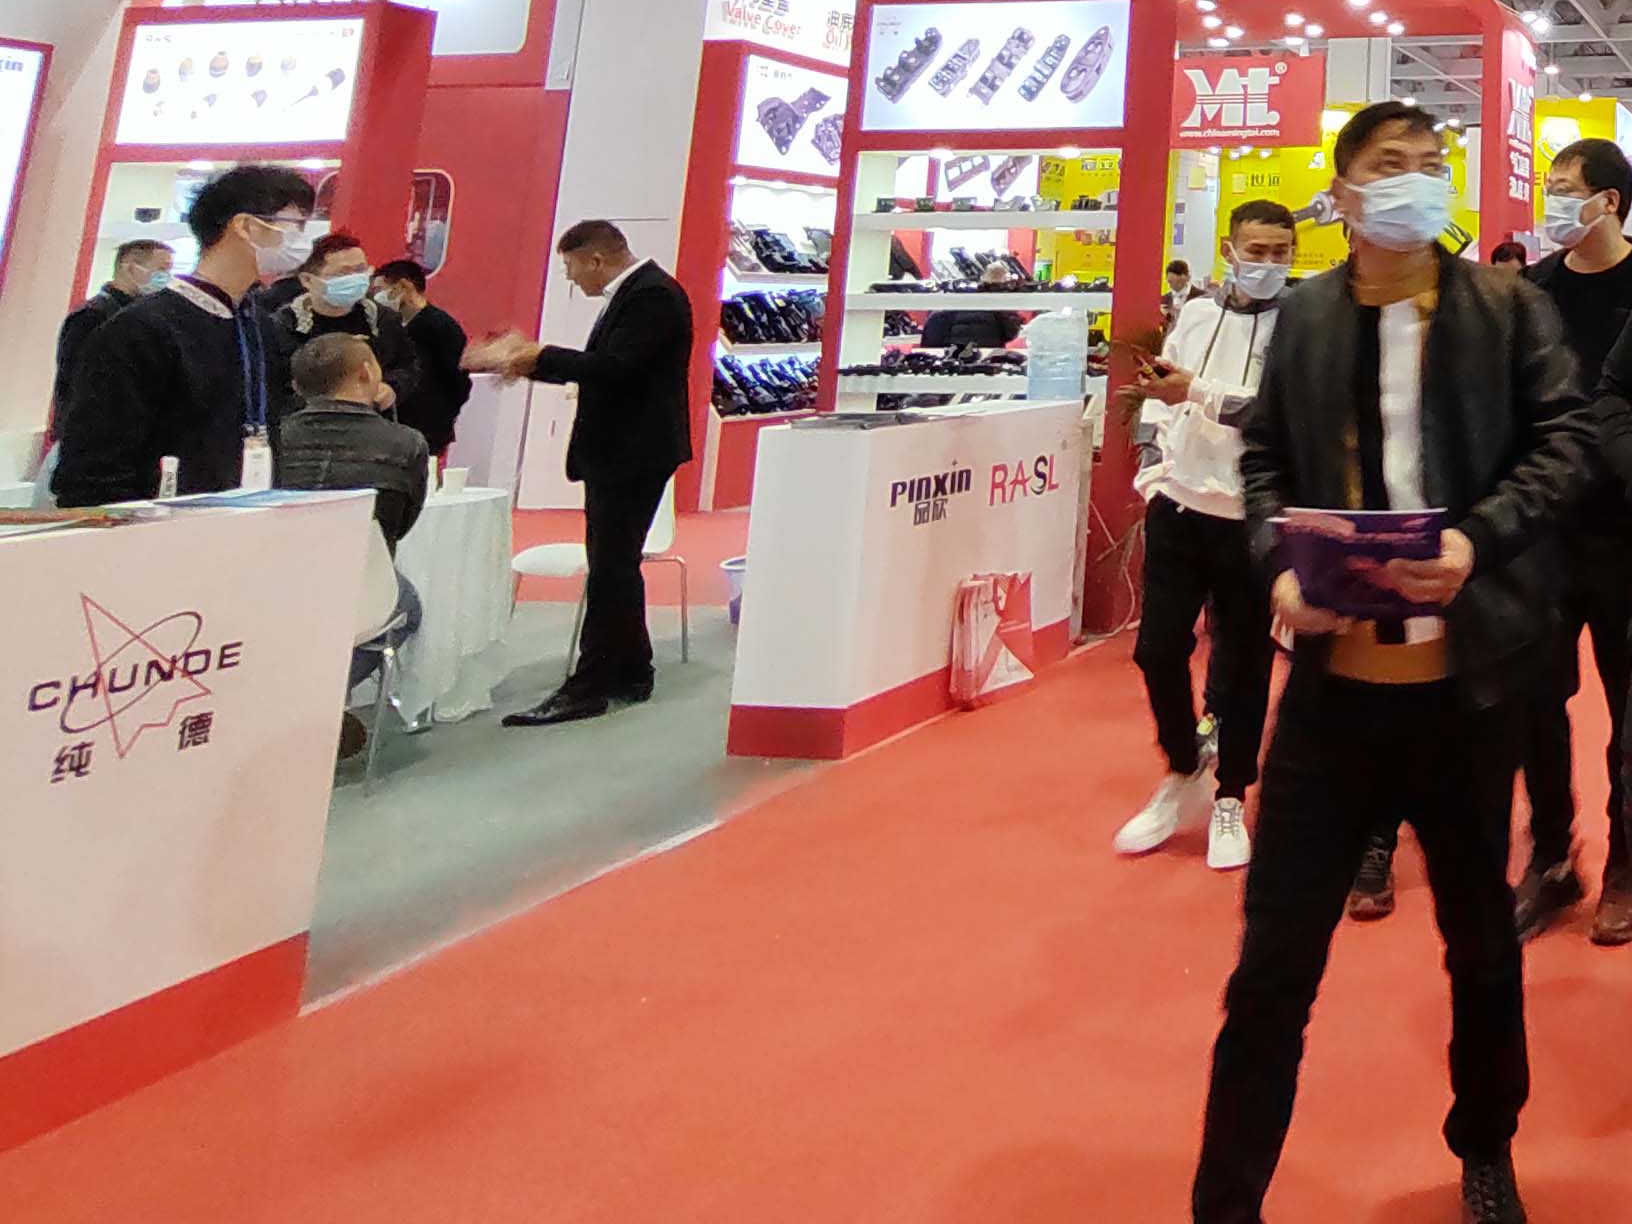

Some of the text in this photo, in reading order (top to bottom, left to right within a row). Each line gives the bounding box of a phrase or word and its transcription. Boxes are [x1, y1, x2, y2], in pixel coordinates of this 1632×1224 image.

[988, 455, 1060, 506] RASL
[912, 499, 949, 527] 品欣
[27, 640, 244, 712] CHUNDE
